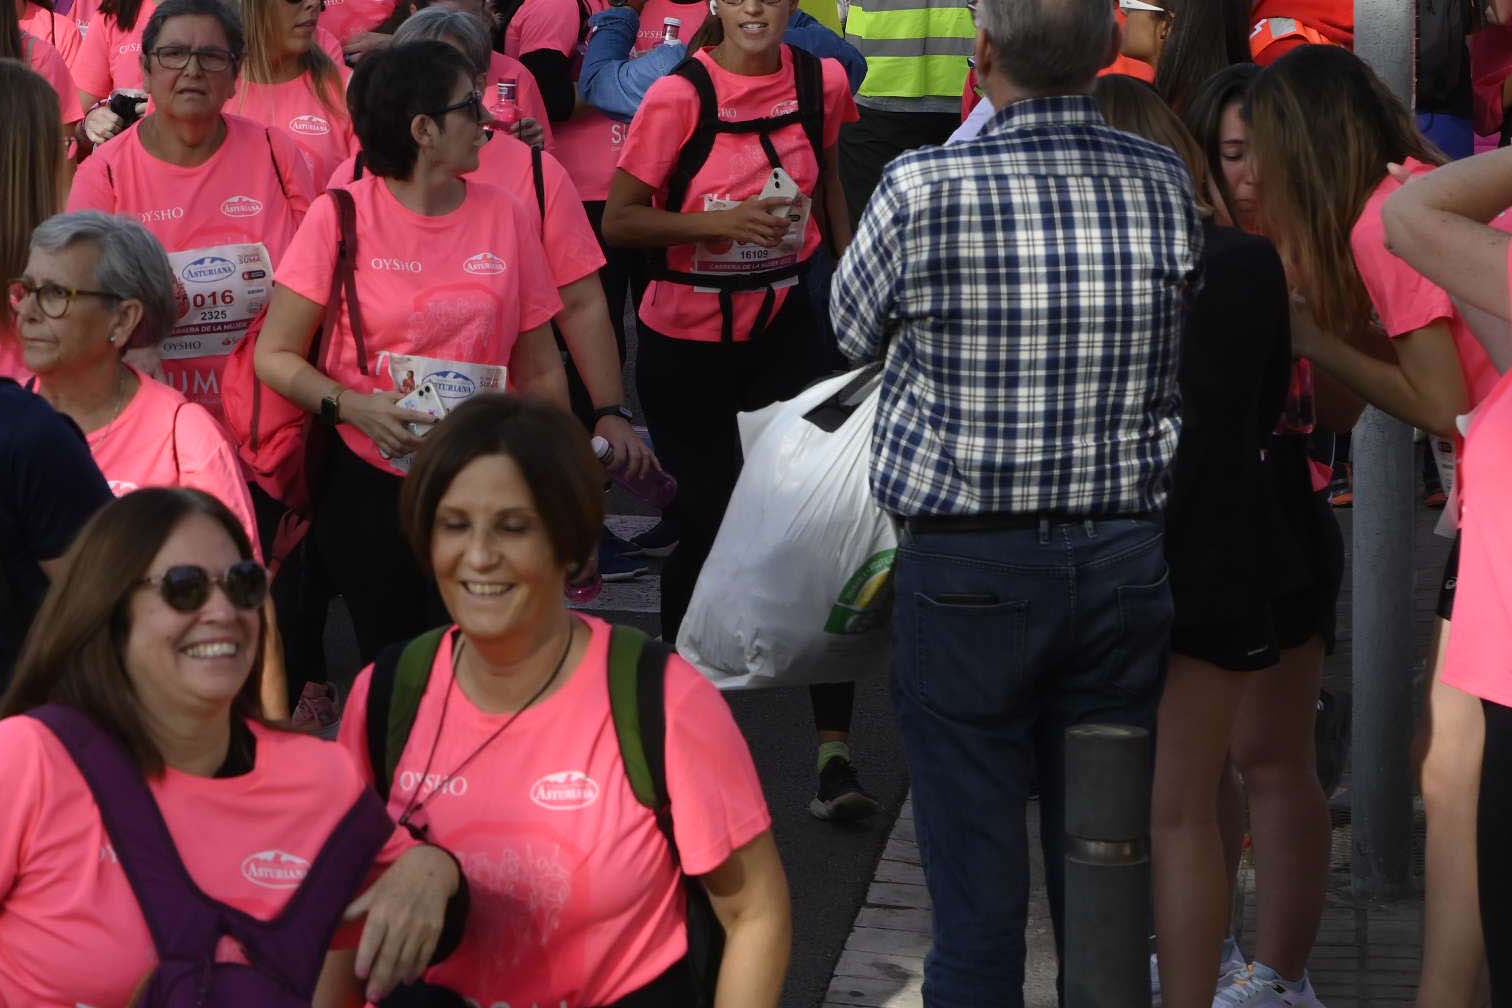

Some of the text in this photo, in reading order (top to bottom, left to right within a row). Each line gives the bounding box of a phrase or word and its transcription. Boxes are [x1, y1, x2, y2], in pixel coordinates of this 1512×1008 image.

[741, 249, 769, 260] 16109
[186, 266, 234, 280] ASTURIANA
[192, 288, 235, 309] 016
[200, 309, 228, 321] 2325
[163, 341, 202, 352] OYSHO
